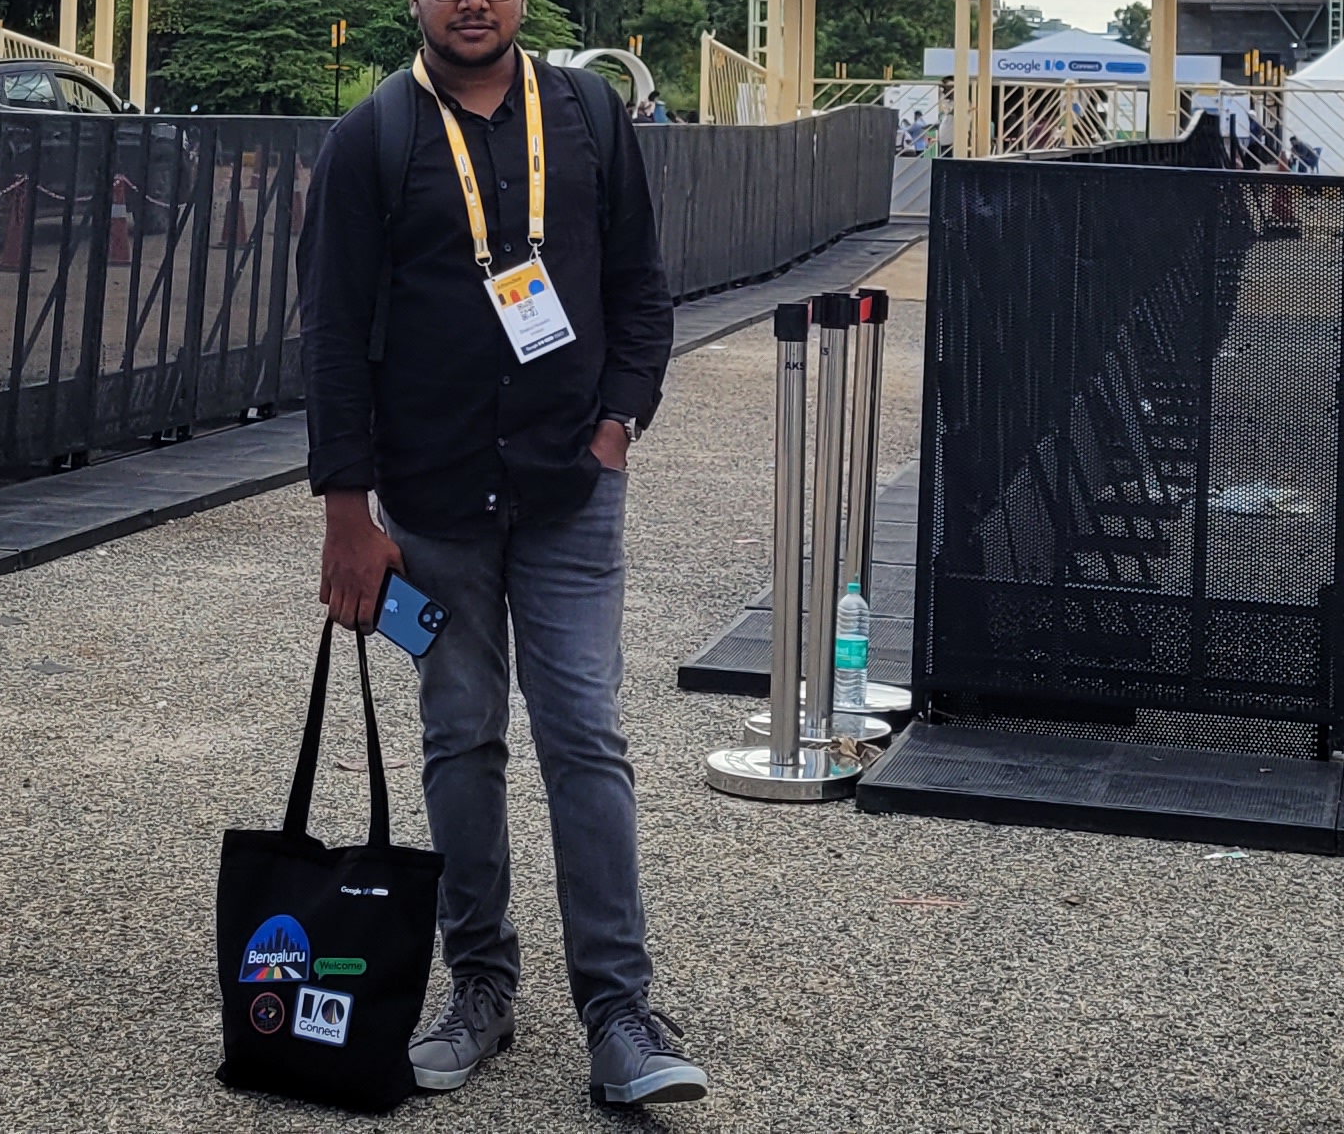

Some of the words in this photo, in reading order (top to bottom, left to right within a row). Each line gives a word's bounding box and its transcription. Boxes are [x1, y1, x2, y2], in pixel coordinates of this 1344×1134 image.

[997, 58, 1041, 74] Google
[1071, 61, 1099, 71] Connect
[247, 949, 306, 967] Bengaluru
[319, 960, 363, 971] Welcome
[298, 1020, 341, 1039] Connect
